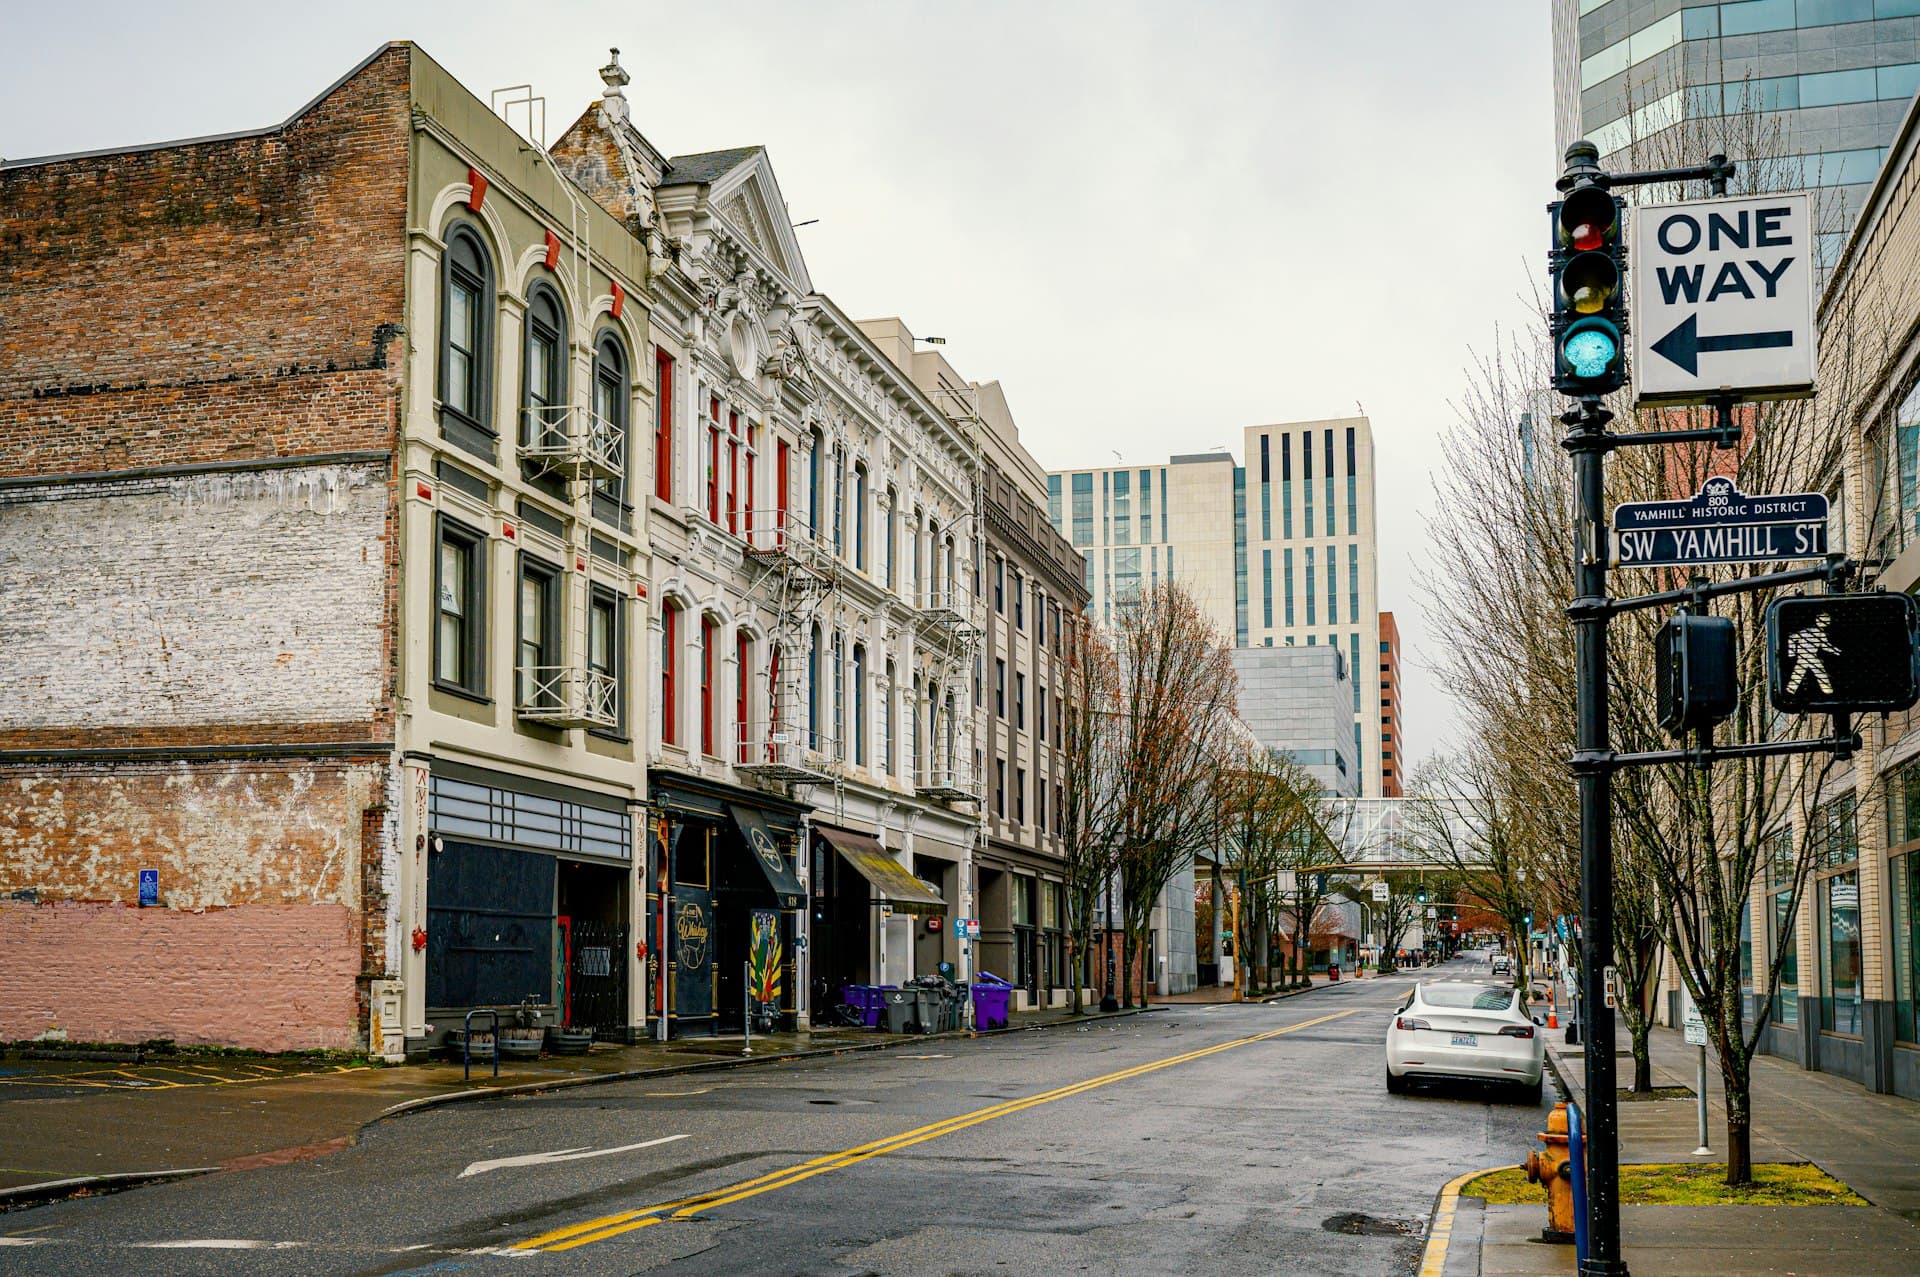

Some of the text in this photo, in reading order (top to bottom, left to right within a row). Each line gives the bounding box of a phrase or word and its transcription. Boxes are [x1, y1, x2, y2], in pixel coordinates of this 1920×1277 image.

[1657, 207, 1793, 256] ONE
[1656, 257, 1796, 305] WAY
[1634, 501, 1807, 521] YAMHILL HISTORIC DISTRICT
[1708, 496, 1729, 507] 800
[1620, 523, 1822, 562] SW YAMHILL ST
[958, 927, 965, 937] 2
